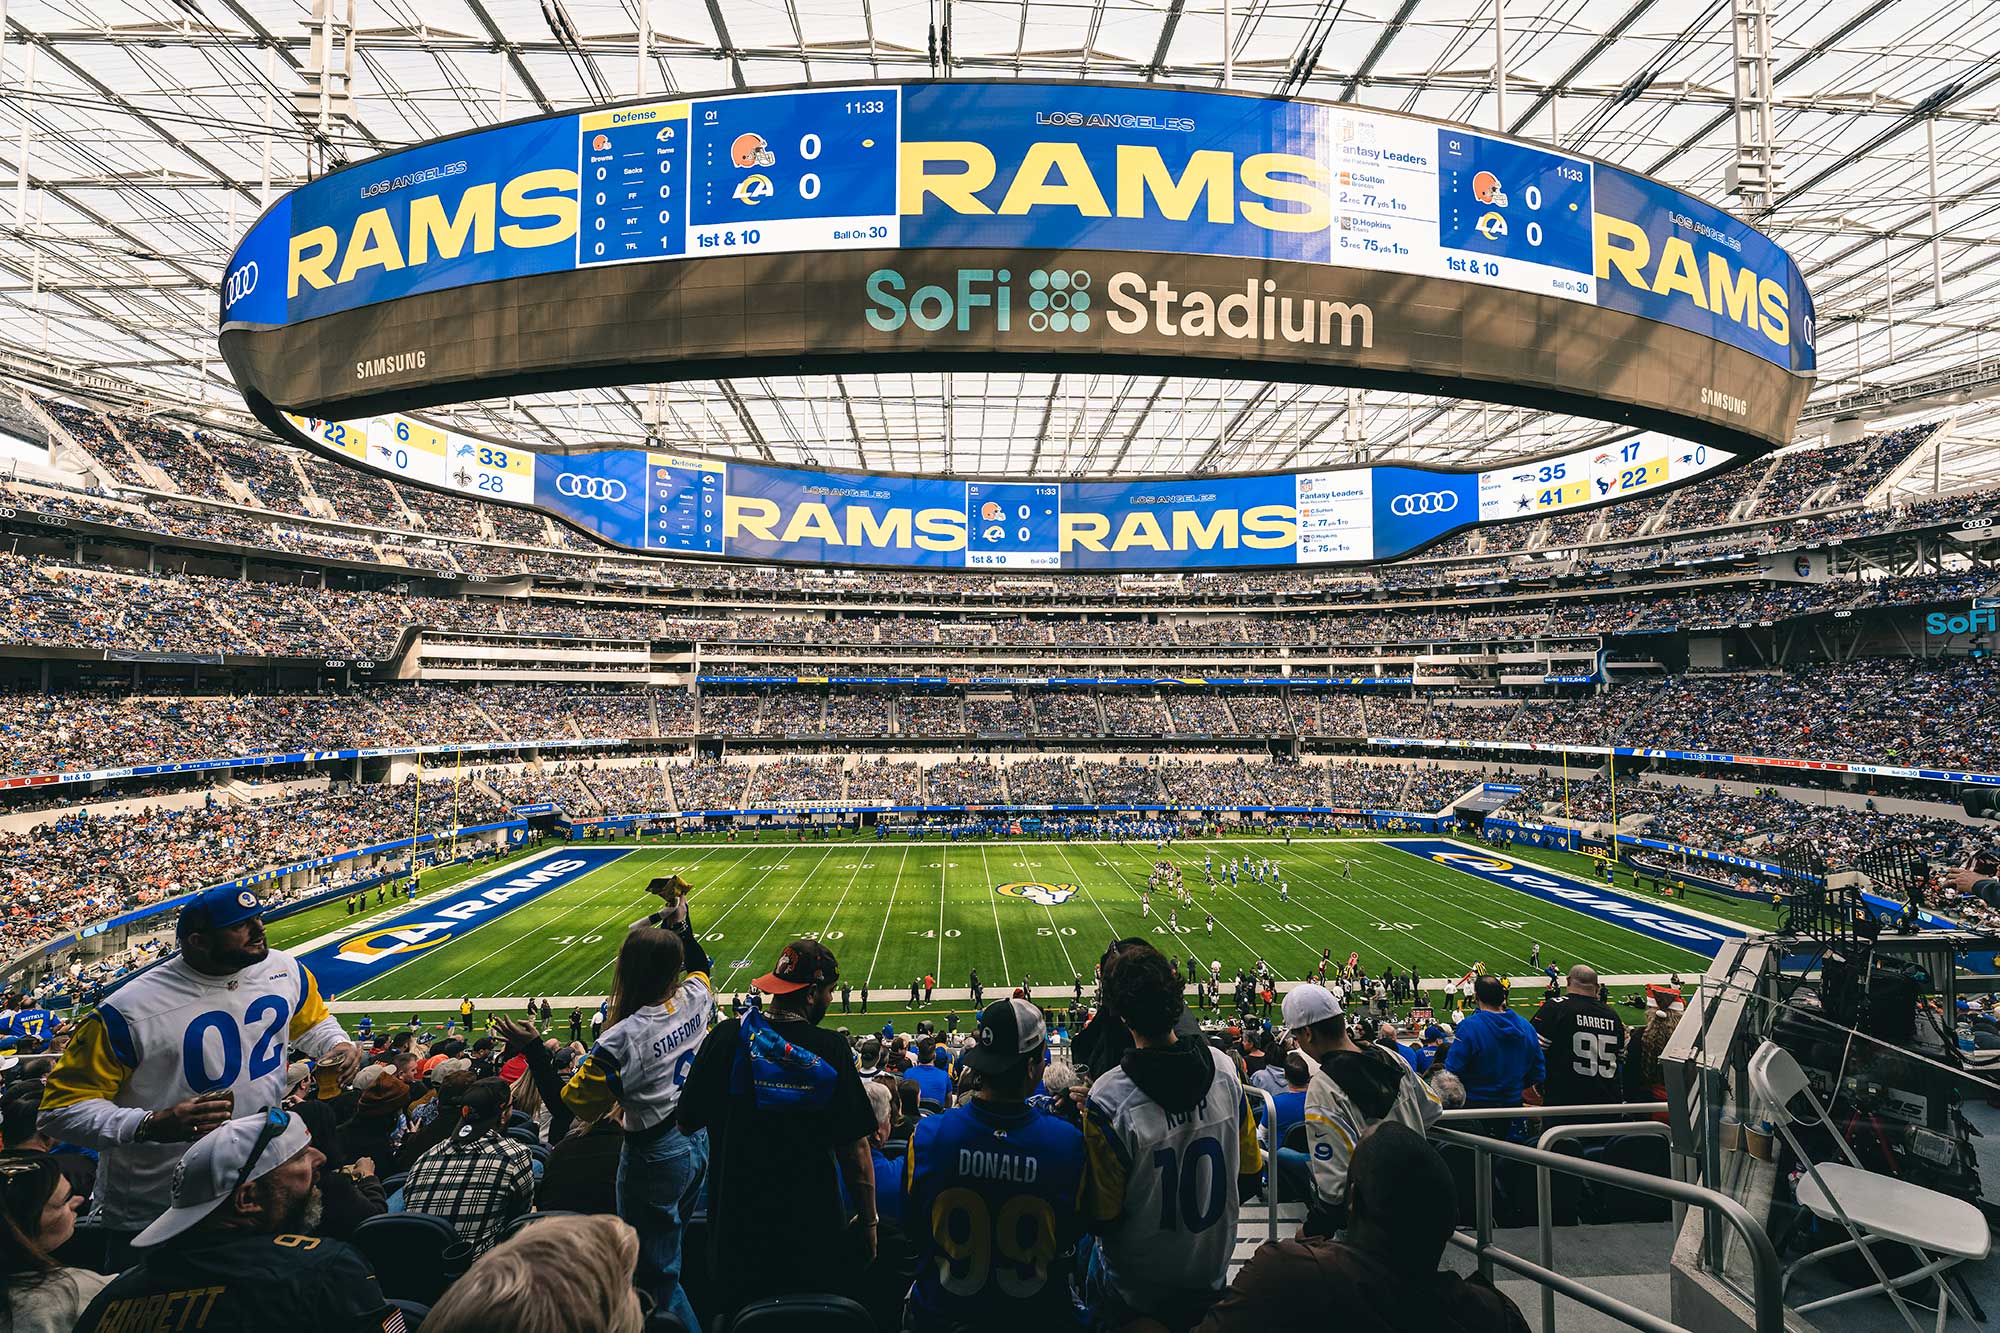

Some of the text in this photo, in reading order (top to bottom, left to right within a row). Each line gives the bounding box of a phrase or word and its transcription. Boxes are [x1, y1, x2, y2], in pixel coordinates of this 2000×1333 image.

[704, 110, 718, 122] Q1
[844, 101, 884, 115] 11:33
[612, 111, 656, 124] Defense
[1036, 111, 1196, 132] LOS ANGELES
[799, 133, 822, 161] 0
[1449, 140, 1462, 150] Q1
[591, 154, 614, 164] Browns
[1383, 149, 1428, 166] Leaders
[596, 167, 606, 180] 0
[624, 167, 643, 175] Sacks
[660, 160, 671, 174] 0
[1556, 166, 1583, 182] 11:33
[361, 161, 468, 198] LOS ANGELES
[798, 172, 822, 200] 0
[900, 140, 1330, 233] RAMS
[1351, 173, 1385, 184] C.Sutton
[596, 192, 606, 206] 0
[628, 192, 637, 200] FF
[660, 185, 670, 198] 0
[1340, 192, 1348, 202] 2
[1362, 194, 1376, 206] 77
[1525, 185, 1542, 211] 0
[595, 217, 605, 230] 0
[659, 210, 670, 224] 0
[1352, 218, 1391, 230] D.Hopkins
[288, 169, 578, 299] RAMS
[696, 229, 761, 248] 1st & 10
[833, 226, 888, 240] Ball On 30
[1526, 222, 1542, 247] 0
[1669, 210, 1742, 252] LOS ANGELES
[595, 242, 605, 256] 0
[660, 236, 668, 249] 1
[1340, 236, 1348, 248] 5
[1363, 239, 1378, 251] 75
[1379, 245, 1391, 254] yds
[1446, 257, 1499, 277] 1st & 10
[1552, 280, 1589, 294] Ball On 30
[1594, 212, 1790, 346] RAMS
[865, 269, 1374, 348] SoFi Stadium
[356, 350, 426, 380] SAMSUNG
[1700, 387, 1747, 416] SAMSUNG
[324, 420, 346, 447] 22
[396, 422, 410, 441] 6
[396, 450, 408, 469] 0
[479, 448, 508, 469] 33
[1620, 442, 1641, 463] 17
[1696, 445, 1705, 465] 0
[1538, 463, 1566, 482] 35
[1621, 468, 1647, 489] 22
[478, 473, 504, 493] 28
[660, 490, 668, 498] 0
[705, 495, 712, 503] 0
[802, 485, 890, 500] LOS ANGELES
[1130, 493, 1216, 504] LOS ANGELES
[1538, 488, 1563, 505] 41
[660, 505, 667, 513] 0
[704, 510, 712, 518] 0
[1018, 505, 1030, 520] 0
[659, 520, 667, 528] 0
[704, 524, 712, 532] 0
[726, 495, 966, 552] RAMS
[1060, 505, 1296, 552] RAMS
[659, 536, 666, 544] 0
[1018, 527, 1030, 542] 0
[706, 539, 710, 548] 1
[971, 556, 984, 564] 1st
[996, 556, 1006, 564] 10
[1926, 609, 1995, 635] SoFi
[1668, 844, 1767, 871] RAMS HOUSE
[236, 857, 334, 887] RAMS HOUSE
[436, 858, 587, 920] RAMS
[1491, 872, 1712, 940] RAMS
[920, 929, 961, 938] 40
[1037, 927, 1077, 937] 50
[1261, 923, 1304, 932] 30
[1371, 922, 1414, 931] 20
[554, 934, 603, 945] 10
[801, 931, 844, 940] 30
[269, 972, 288, 980] RAMS
[22, 1019, 43, 1036] 17
[1576, 1014, 1614, 1031] GARRETT
[183, 994, 290, 1094] 02
[653, 1013, 701, 1059] STAFFORD
[1573, 1032, 1617, 1078] 95
[1313, 1142, 1334, 1160] 9
[958, 1148, 1037, 1183] DONALD
[1153, 1137, 1227, 1234] 10
[931, 1187, 1056, 1298] 99
[95, 1285, 225, 1333] GARRETT
